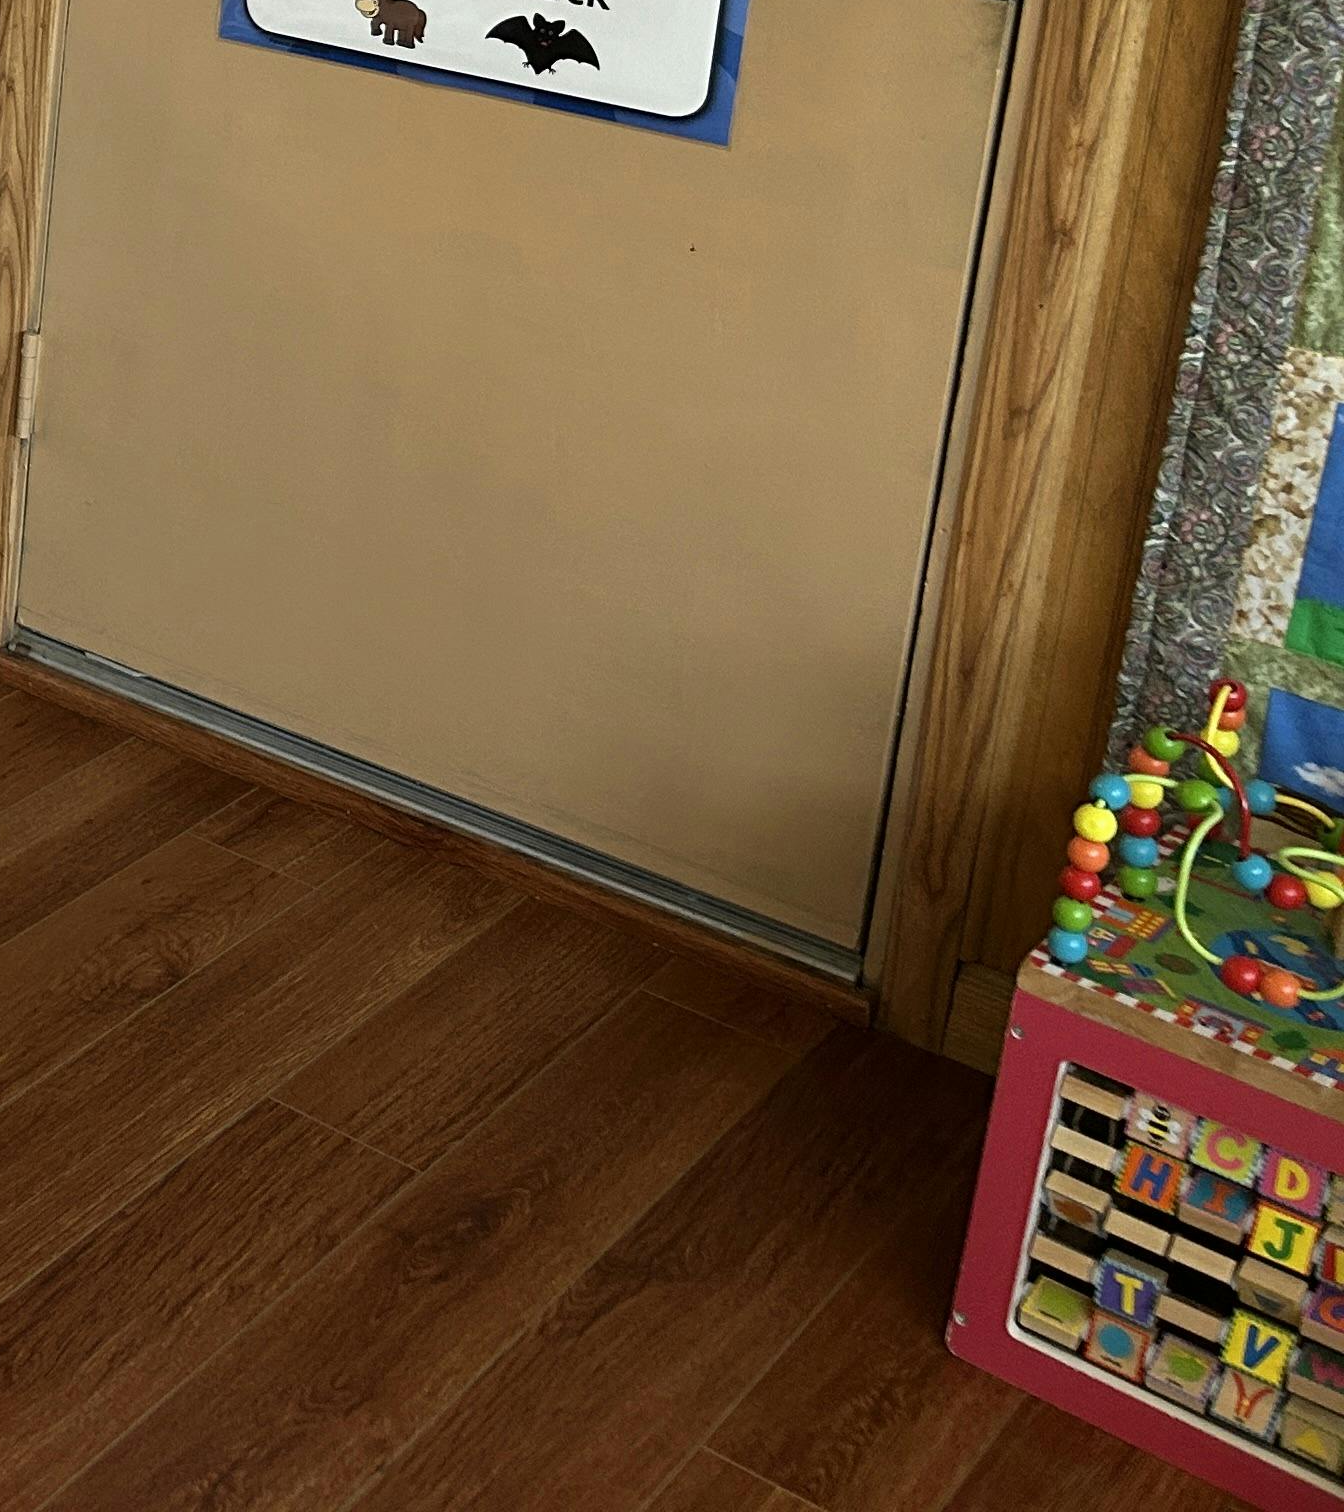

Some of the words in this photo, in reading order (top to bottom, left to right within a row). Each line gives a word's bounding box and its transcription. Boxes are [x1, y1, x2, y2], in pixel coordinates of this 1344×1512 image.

[1207, 1129, 1248, 1169] C
[1131, 1154, 1174, 1200] H
[1275, 1160, 1309, 1199] D
[1264, 1219, 1304, 1261] J
[1115, 1273, 1143, 1314] T
[1243, 1324, 1279, 1370] V
